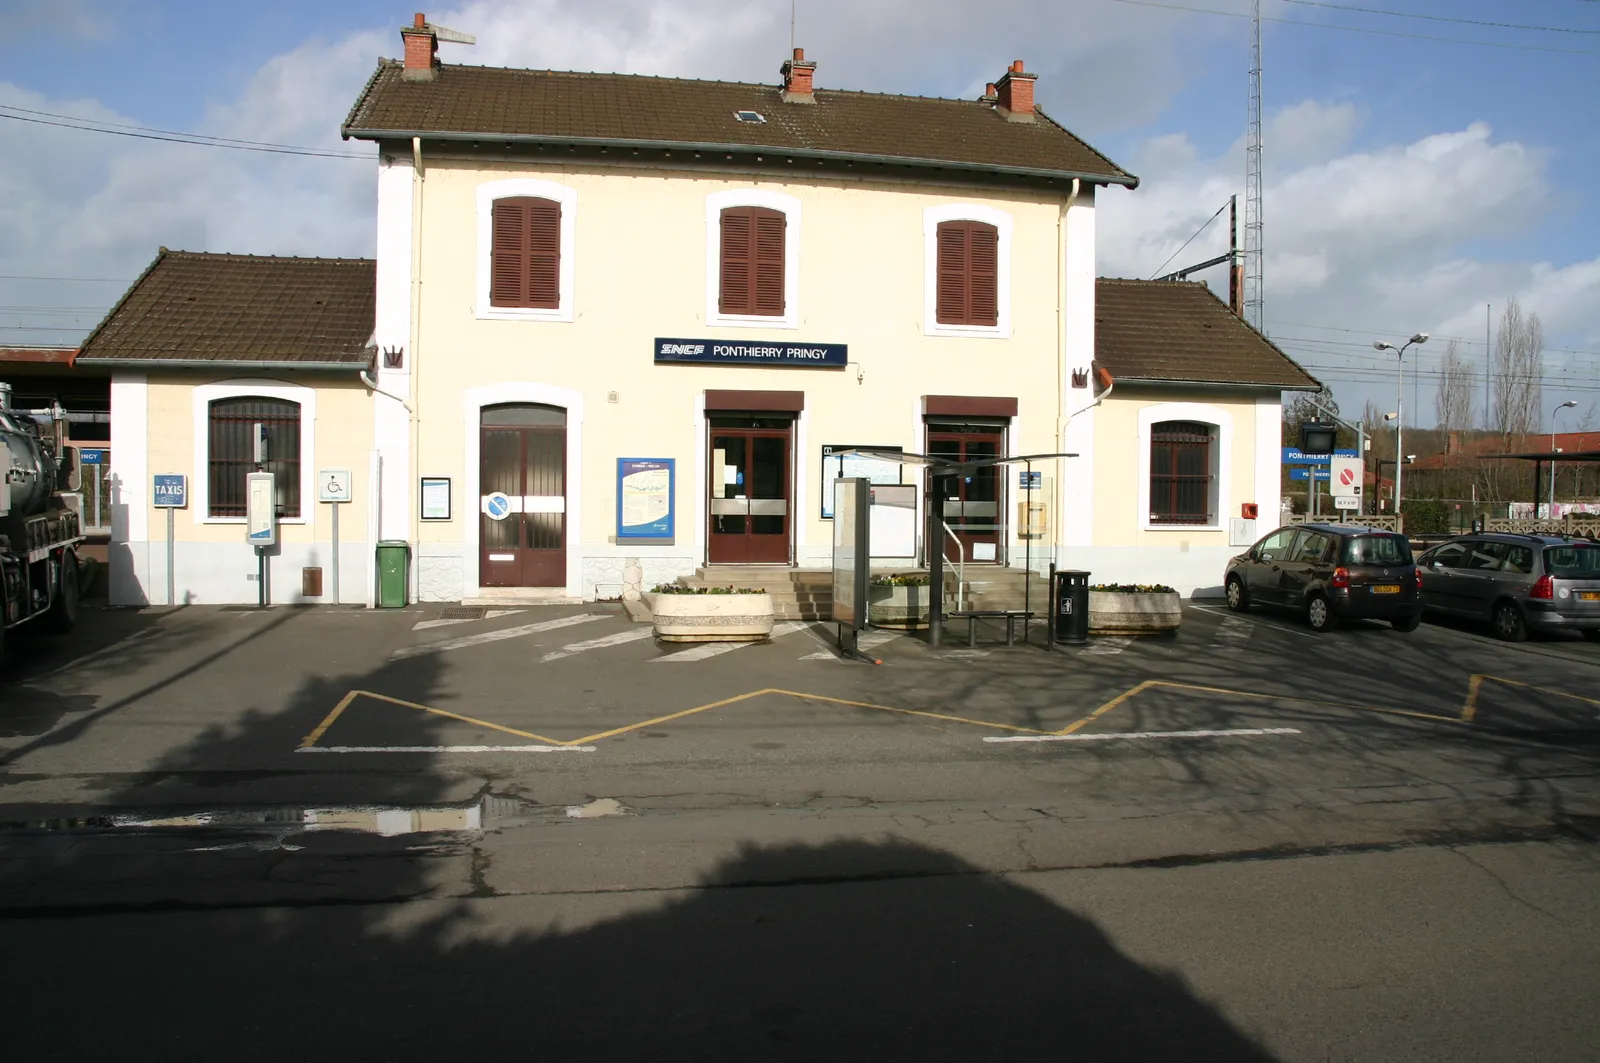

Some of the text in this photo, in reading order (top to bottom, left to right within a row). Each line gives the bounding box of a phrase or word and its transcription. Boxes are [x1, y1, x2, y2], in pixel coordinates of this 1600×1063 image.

[660, 344, 828, 359] SNCF PONTHIERRY PRINGY
[155, 485, 183, 495] TAXIS
